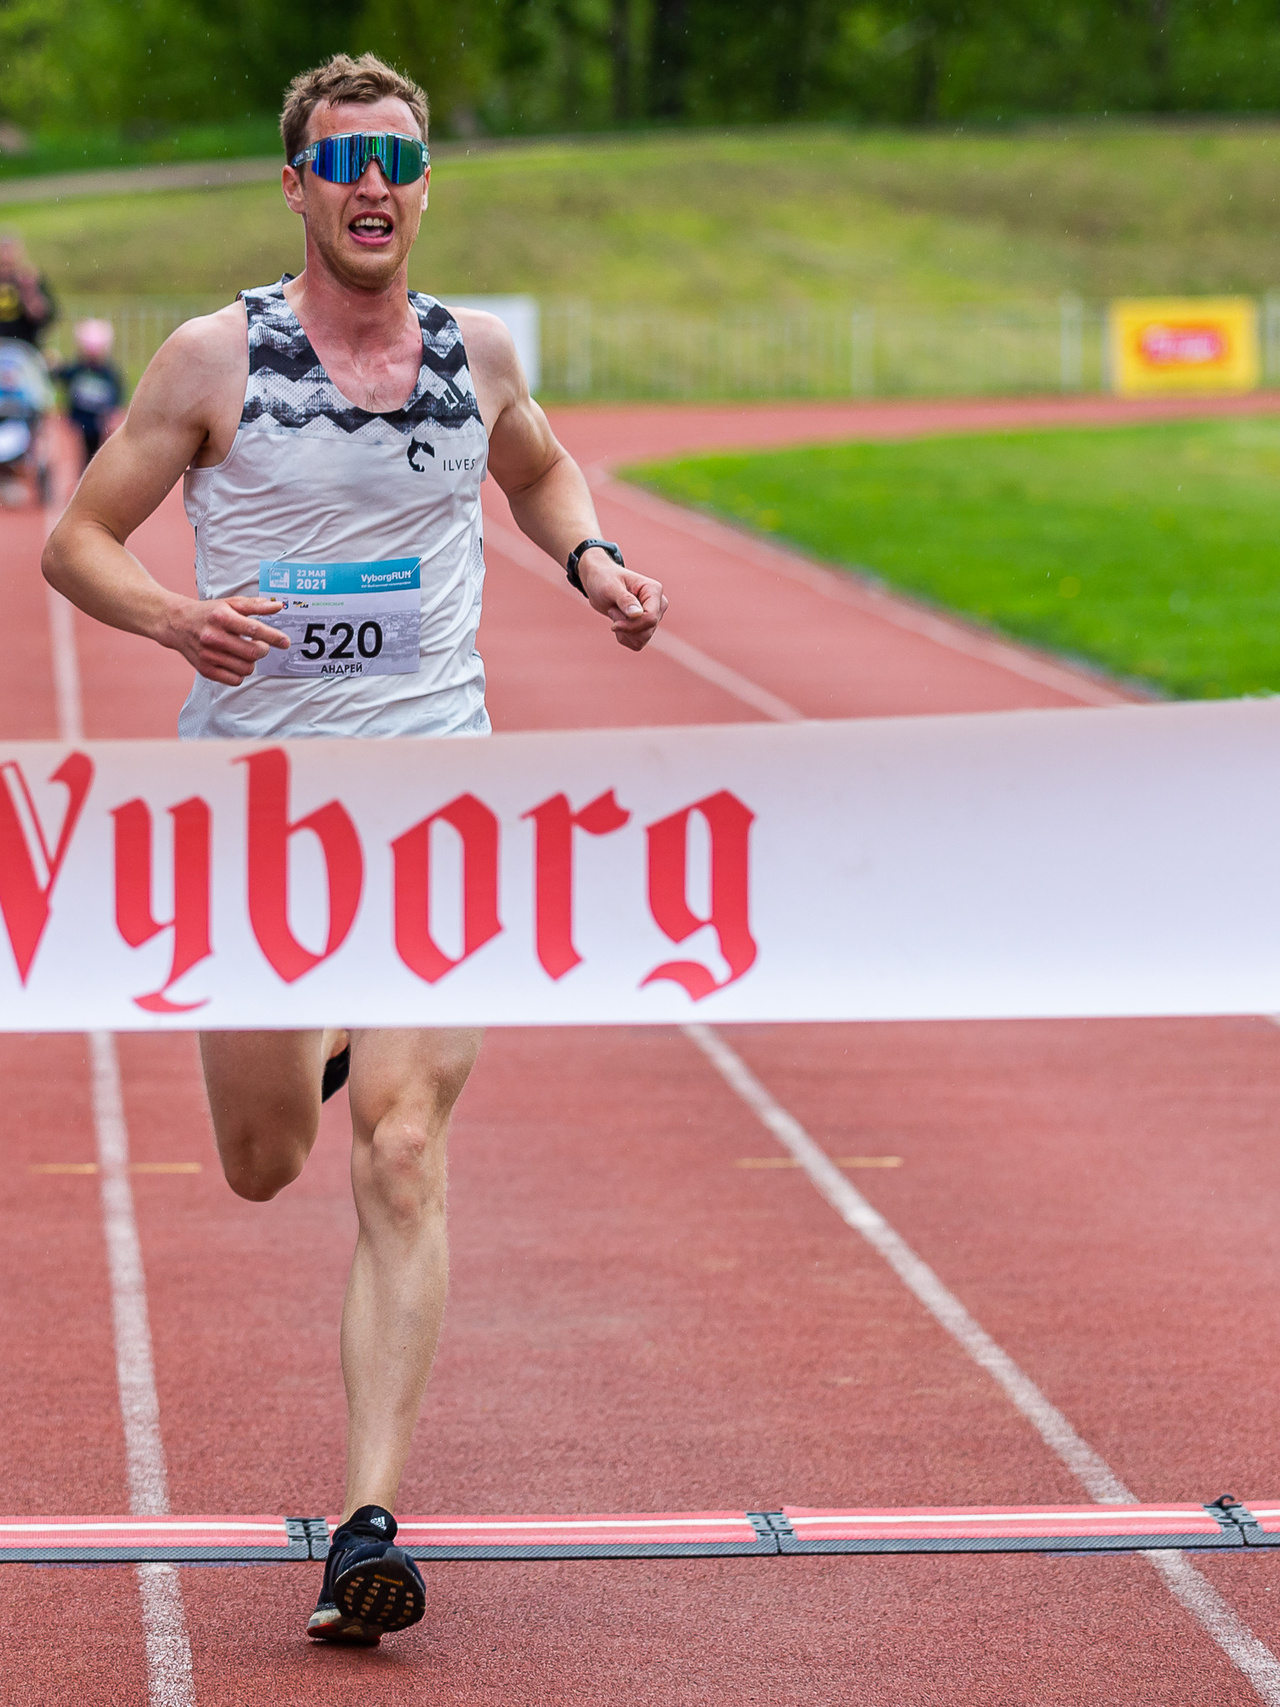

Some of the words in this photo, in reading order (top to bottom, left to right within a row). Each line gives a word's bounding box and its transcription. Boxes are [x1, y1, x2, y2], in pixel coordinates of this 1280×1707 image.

[443, 459, 476, 471] ILVES
[297, 569, 307, 577] 23
[308, 569, 326, 577] МАЯ
[296, 578, 326, 590] 2021
[300, 620, 383, 660] 520
[320, 662, 363, 674] АНДРЕЙ
